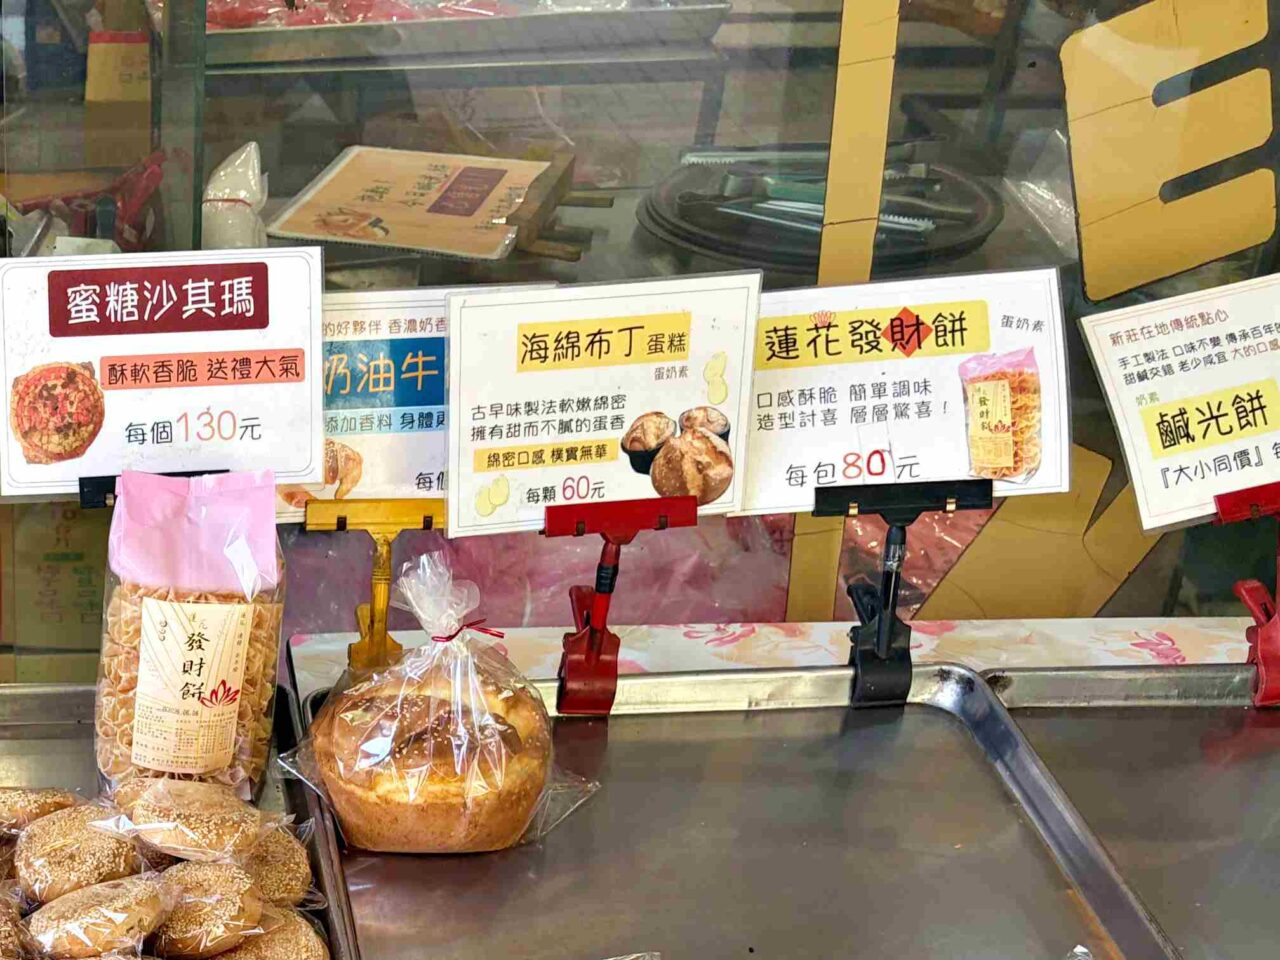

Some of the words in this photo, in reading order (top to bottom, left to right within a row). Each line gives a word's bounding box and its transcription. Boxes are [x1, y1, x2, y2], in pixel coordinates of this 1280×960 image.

[66, 276, 255, 325] 蜜糖沙其瑪
[765, 310, 967, 361] 蓮花發財餅
[1000, 314, 1046, 333] 蛋奶素
[1118, 349, 1170, 370] 手工製法
[1172, 336, 1223, 357] 口味不變
[1178, 351, 1228, 372] 老少咸宜
[108, 359, 198, 385] 酥軟香脆
[206, 355, 300, 380] 送禮大氣
[654, 365, 689, 380] 蛋奶素
[471, 394, 627, 421] 古早味製法軟嫩綿密
[757, 387, 837, 409] 口感酥脆
[849, 378, 933, 401] 簡單調味
[125, 410, 262, 445] 每個130元
[471, 415, 625, 442] 擁有甜而不膩的蛋香
[756, 407, 838, 431] 造型討喜
[1156, 389, 1268, 450] 鹹光餅
[487, 449, 546, 468] 綿密口感
[551, 443, 607, 463] 樸實無華
[180, 632, 210, 701] 發財餅
